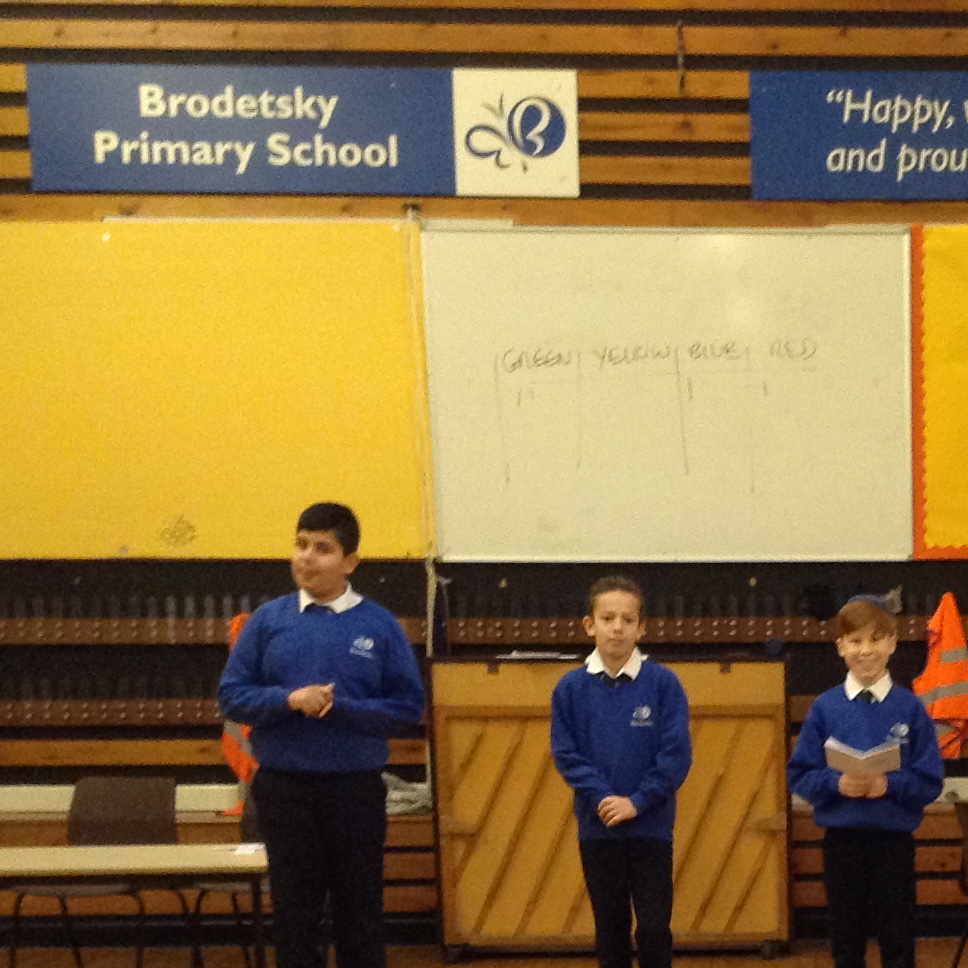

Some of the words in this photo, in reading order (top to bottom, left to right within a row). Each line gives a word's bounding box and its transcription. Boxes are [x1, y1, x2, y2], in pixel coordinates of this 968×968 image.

[138, 84, 338, 128] Brodetsky
[93, 131, 253, 174] Primary
[267, 135, 399, 167] School
[826, 137, 885, 173] and
[502, 349, 572, 373] GREEN
[688, 341, 740, 360] BLUE
[769, 338, 817, 361] RED
